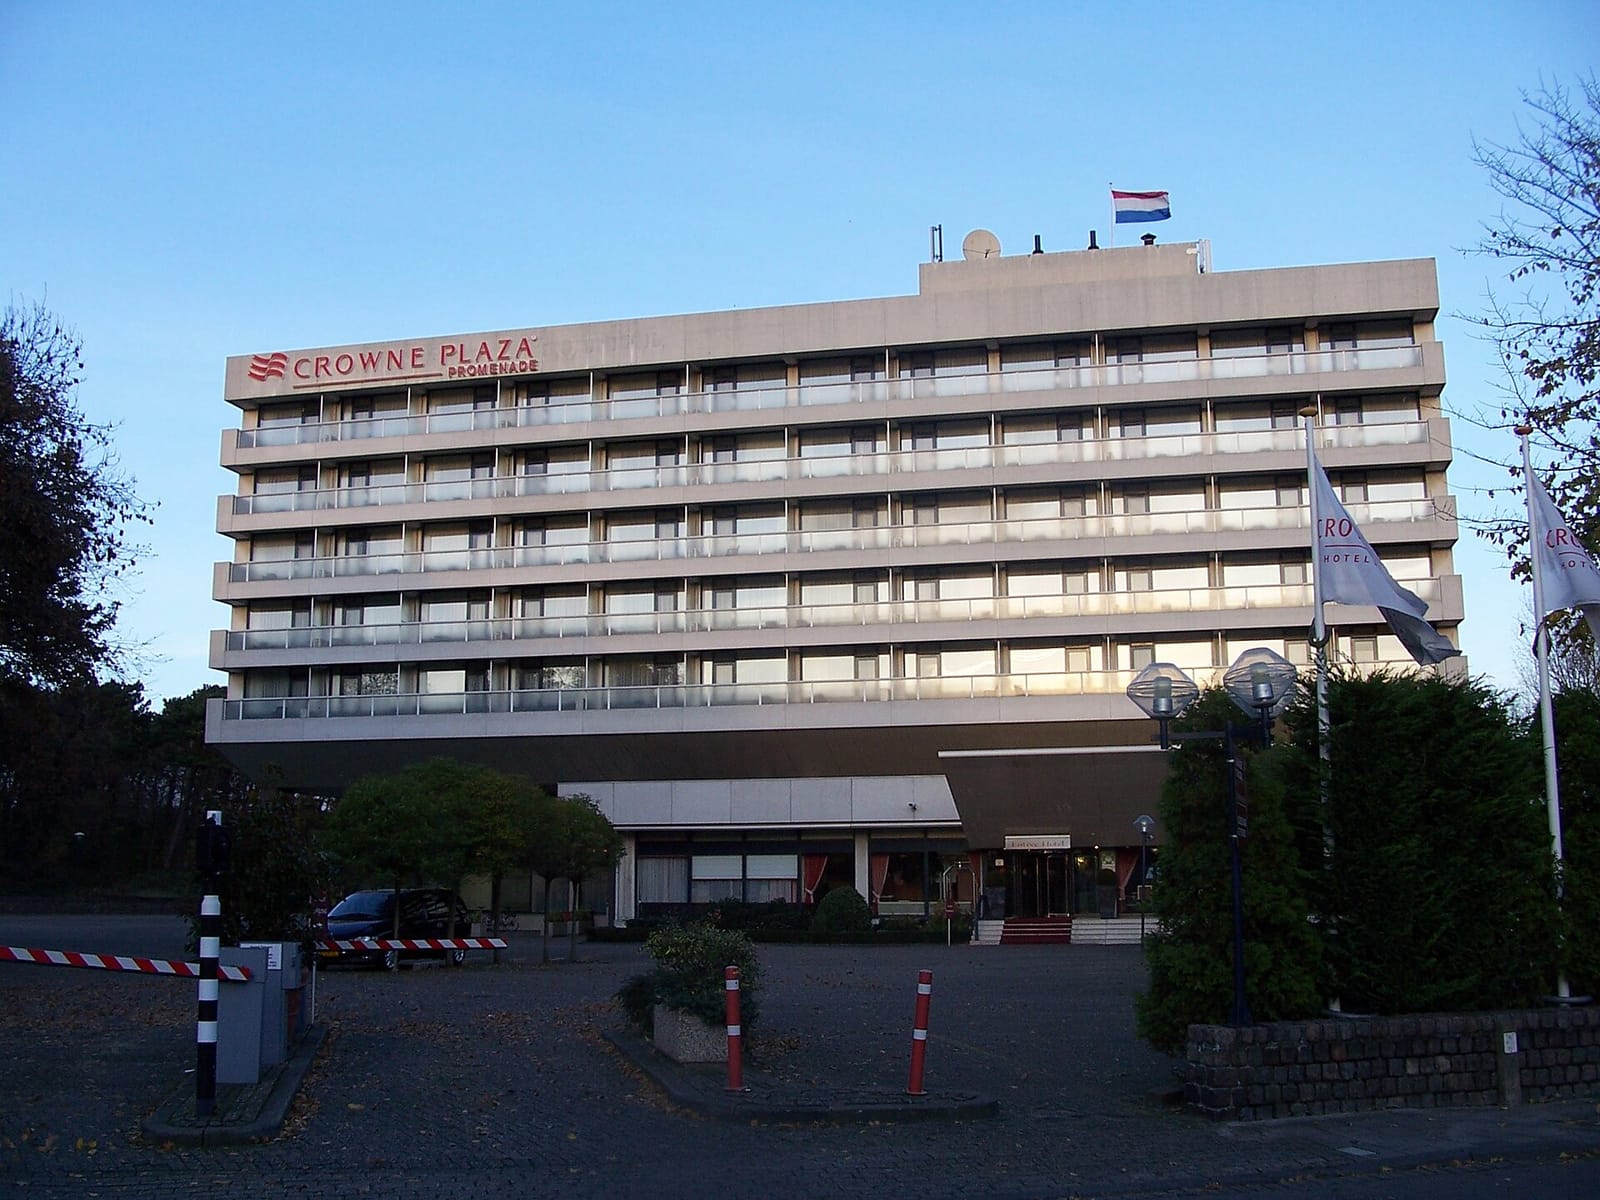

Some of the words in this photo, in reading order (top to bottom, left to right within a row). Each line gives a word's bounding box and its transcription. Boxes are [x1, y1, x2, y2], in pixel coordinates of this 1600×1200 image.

[294, 347, 425, 379] CROWNE
[441, 337, 533, 366] PLAZA
[448, 359, 538, 378] PROMENADE
[1318, 518, 1353, 538] RO
